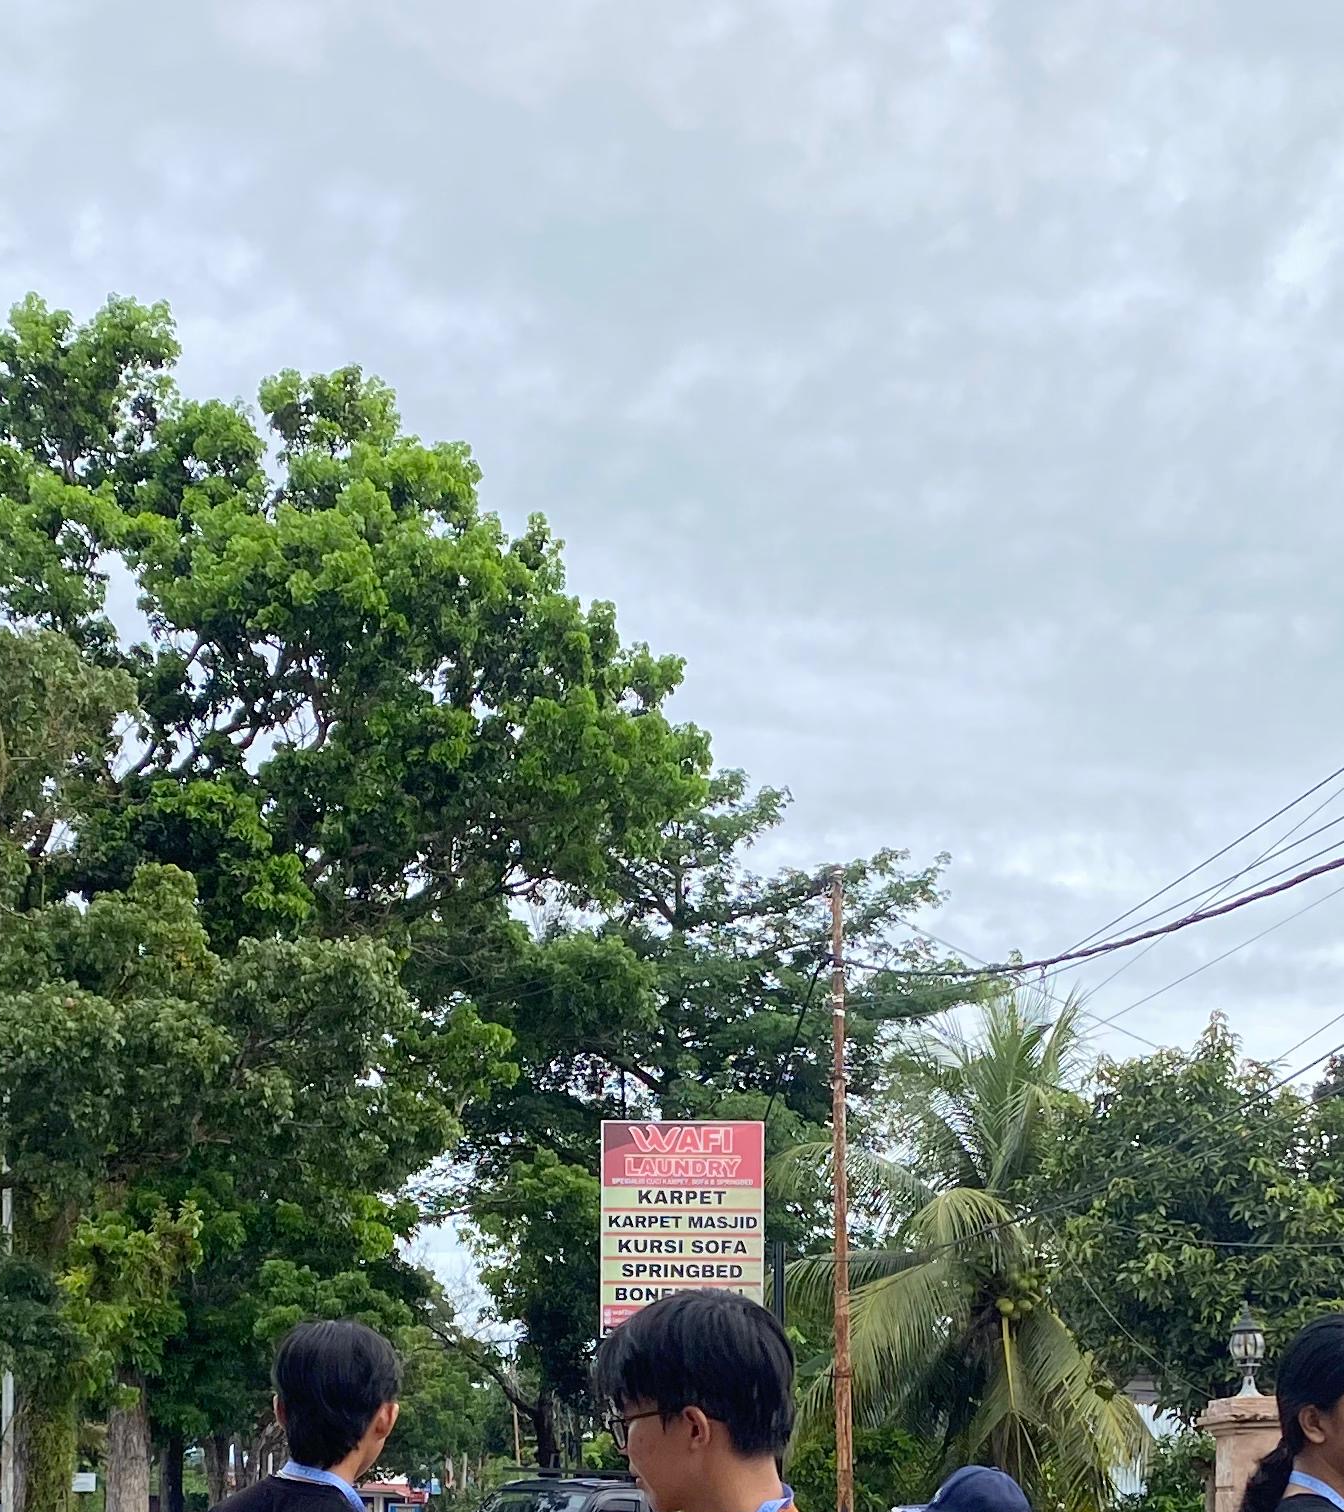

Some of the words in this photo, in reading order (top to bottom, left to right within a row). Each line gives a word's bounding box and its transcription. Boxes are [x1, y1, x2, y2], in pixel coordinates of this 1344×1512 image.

[628, 1124, 734, 1154] WAFI
[624, 1157, 742, 1178] LAUNDRY
[638, 1190, 727, 1205] KARPET
[608, 1215, 682, 1228] KARPET
[688, 1216, 758, 1229] MASJID
[618, 1239, 683, 1254] KURSI
[691, 1240, 747, 1254] SOFA
[621, 1263, 743, 1279] SPRINGBED
